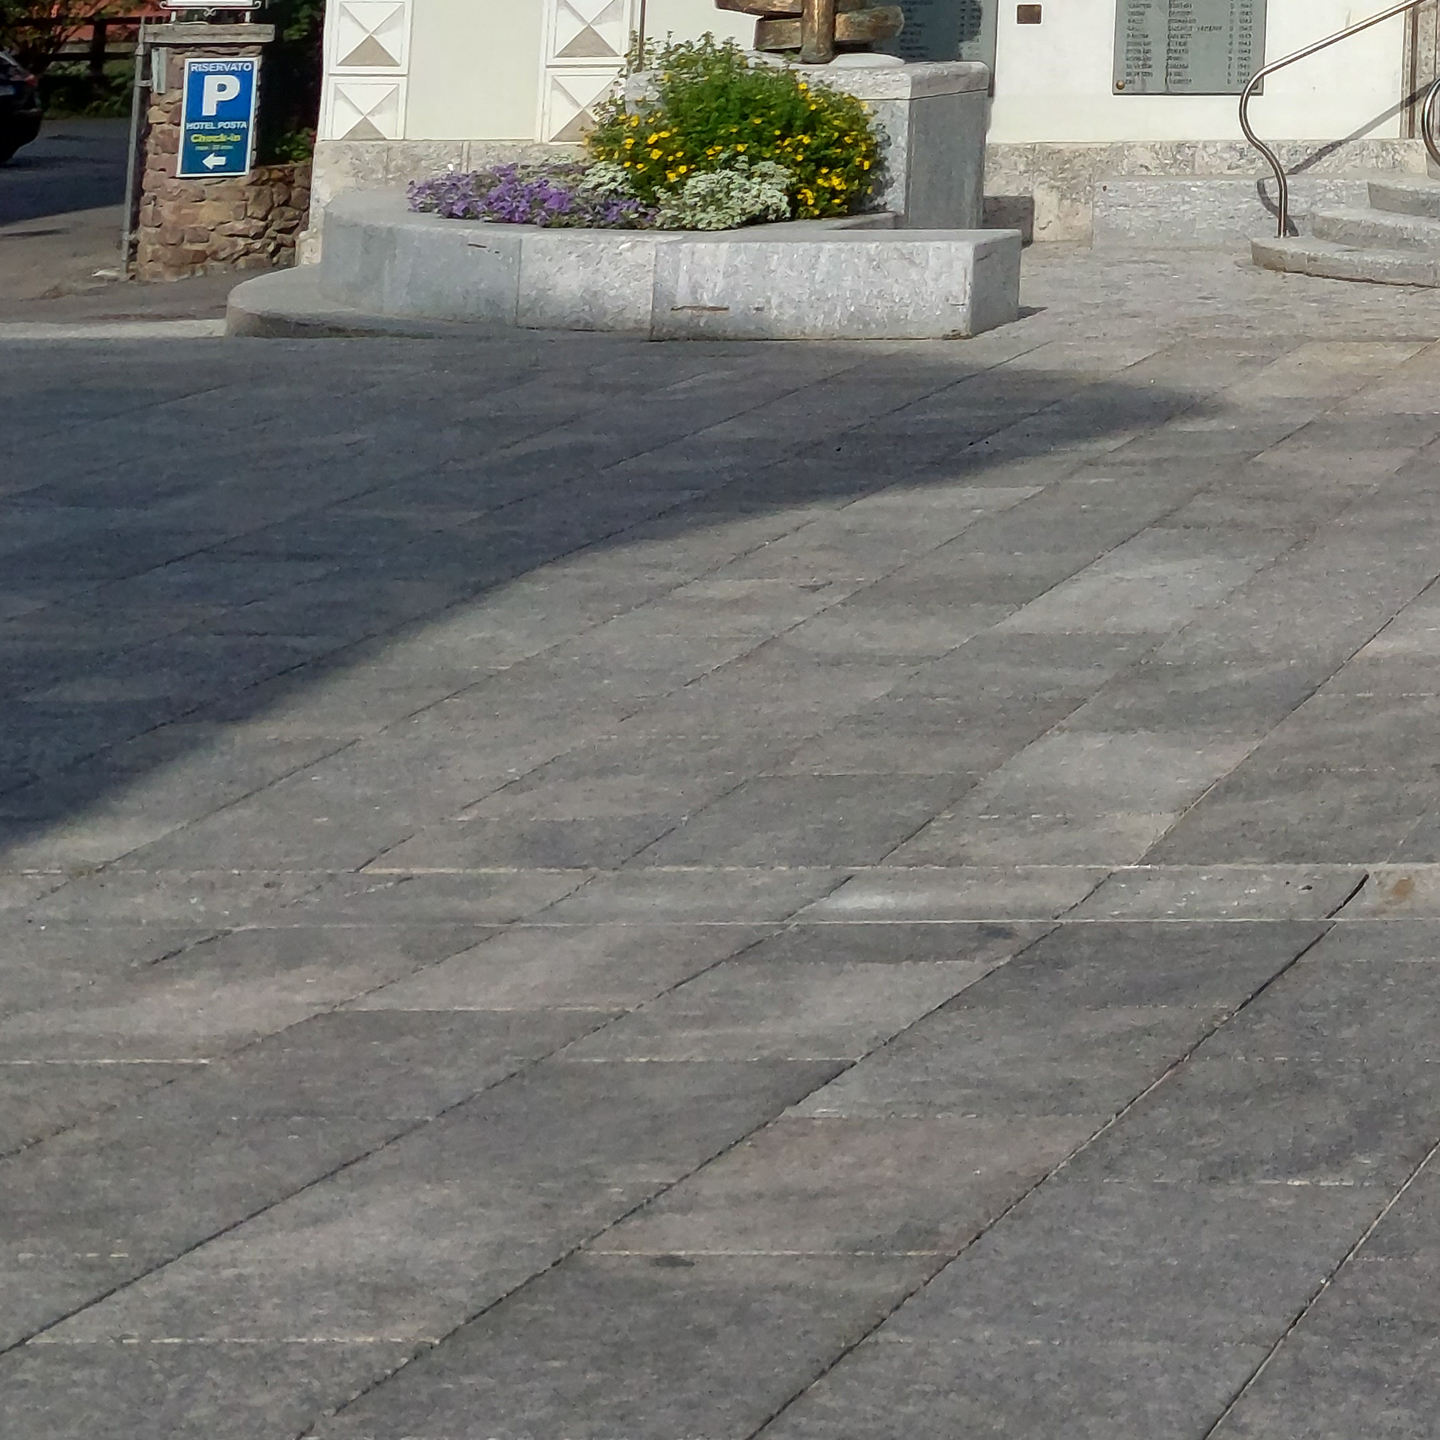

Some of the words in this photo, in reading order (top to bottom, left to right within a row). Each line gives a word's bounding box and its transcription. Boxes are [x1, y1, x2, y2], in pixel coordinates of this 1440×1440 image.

[190, 63, 252, 72] RISERVATO
[202, 75, 240, 116] P
[186, 122, 217, 130] HOTEL
[217, 121, 248, 129] POSTA
